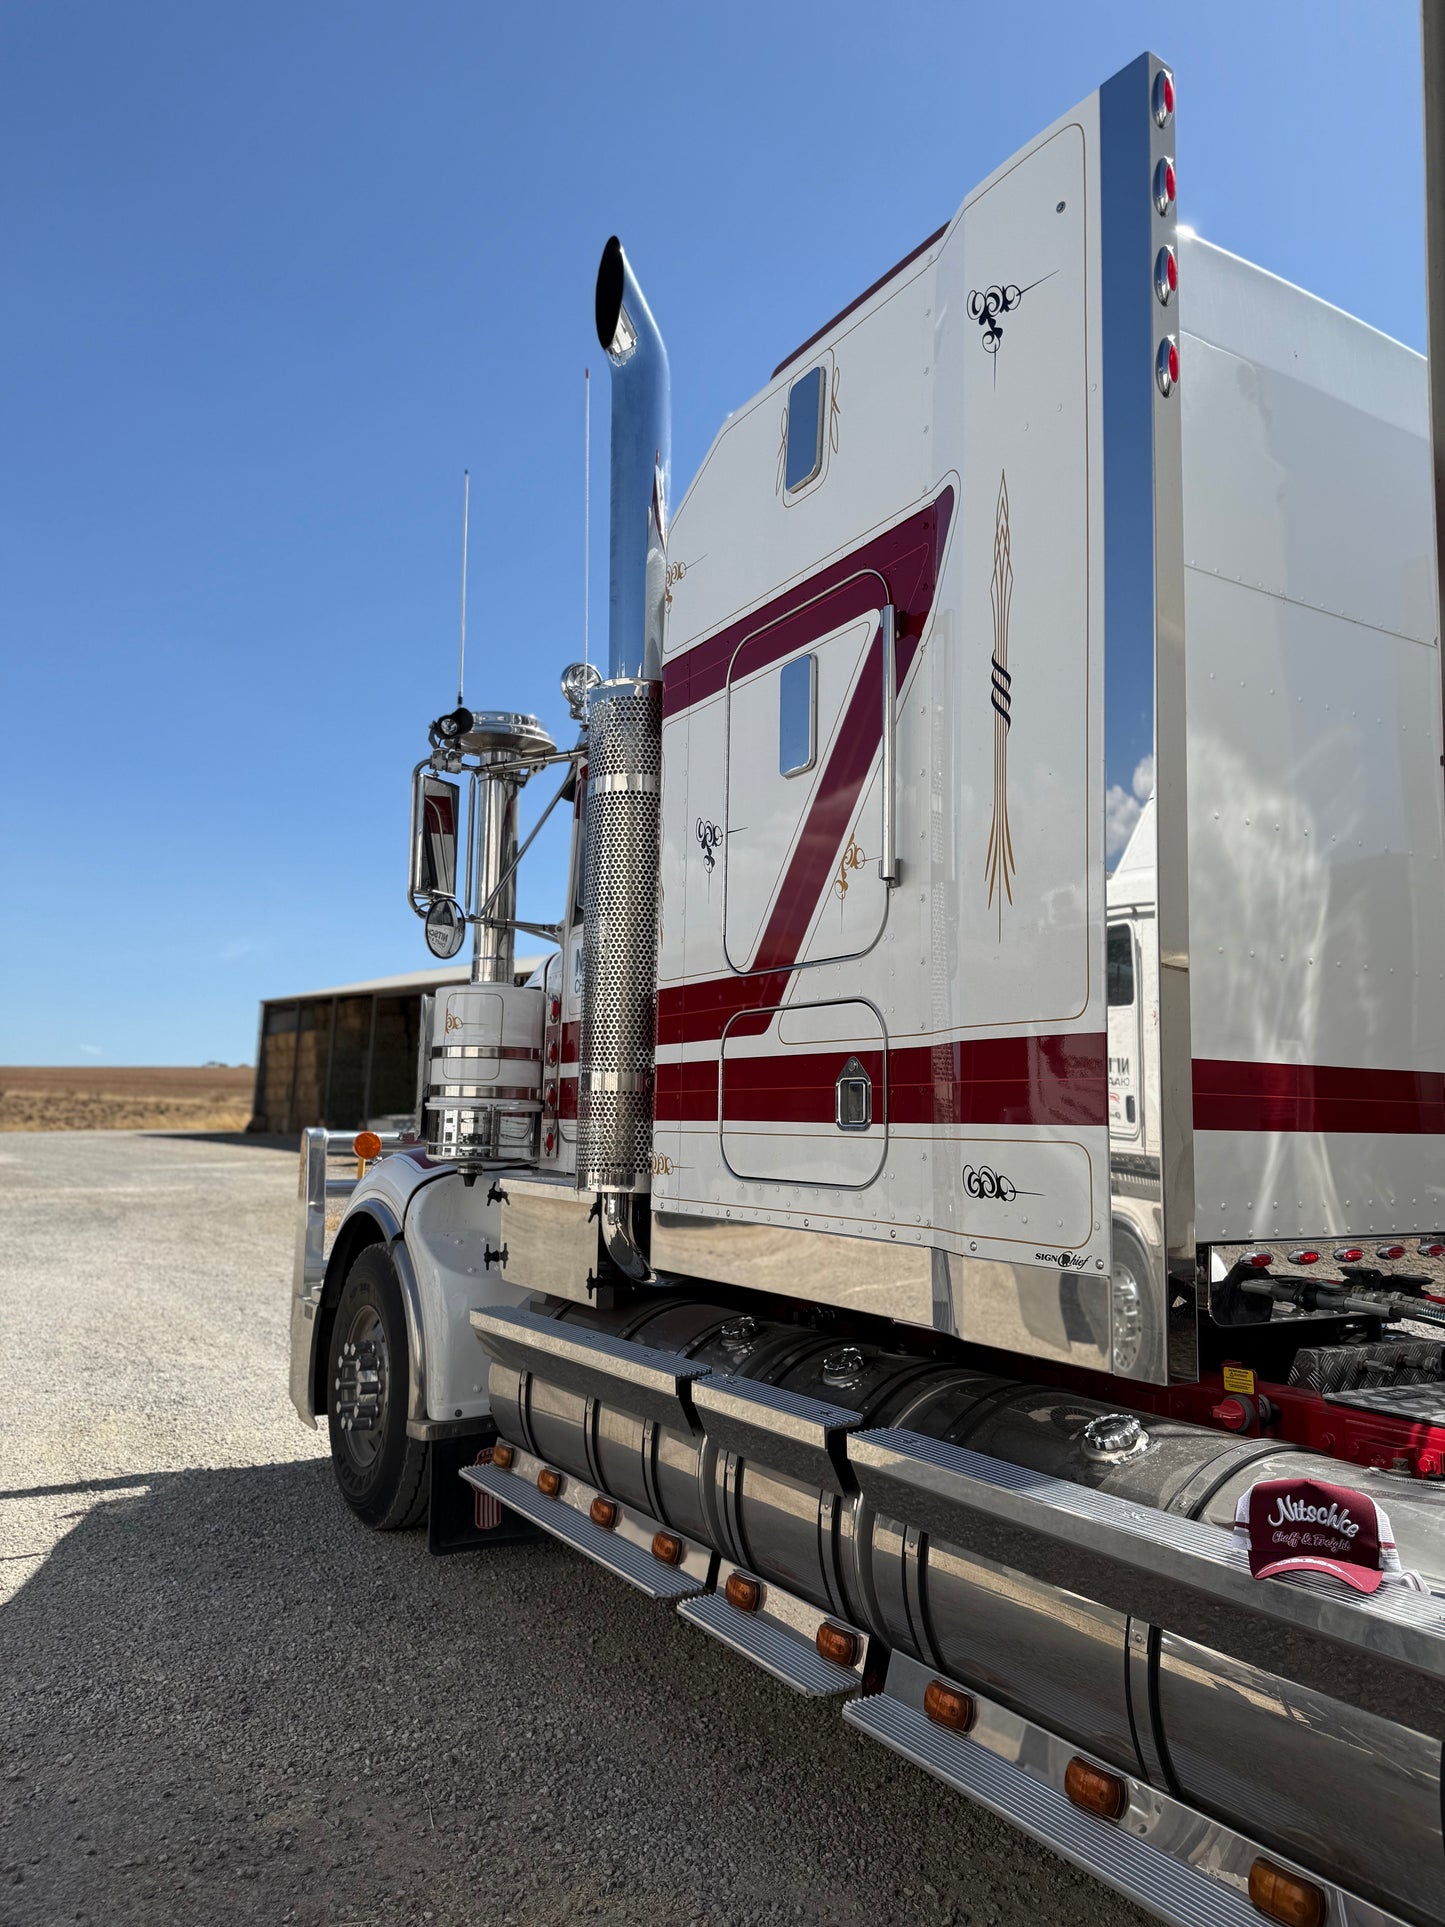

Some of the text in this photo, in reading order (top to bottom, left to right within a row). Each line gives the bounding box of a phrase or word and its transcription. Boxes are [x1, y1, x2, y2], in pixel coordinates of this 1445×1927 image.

[1267, 1494, 1360, 1538] Nitschke
[1272, 1530, 1351, 1553] Chaff & Freight
